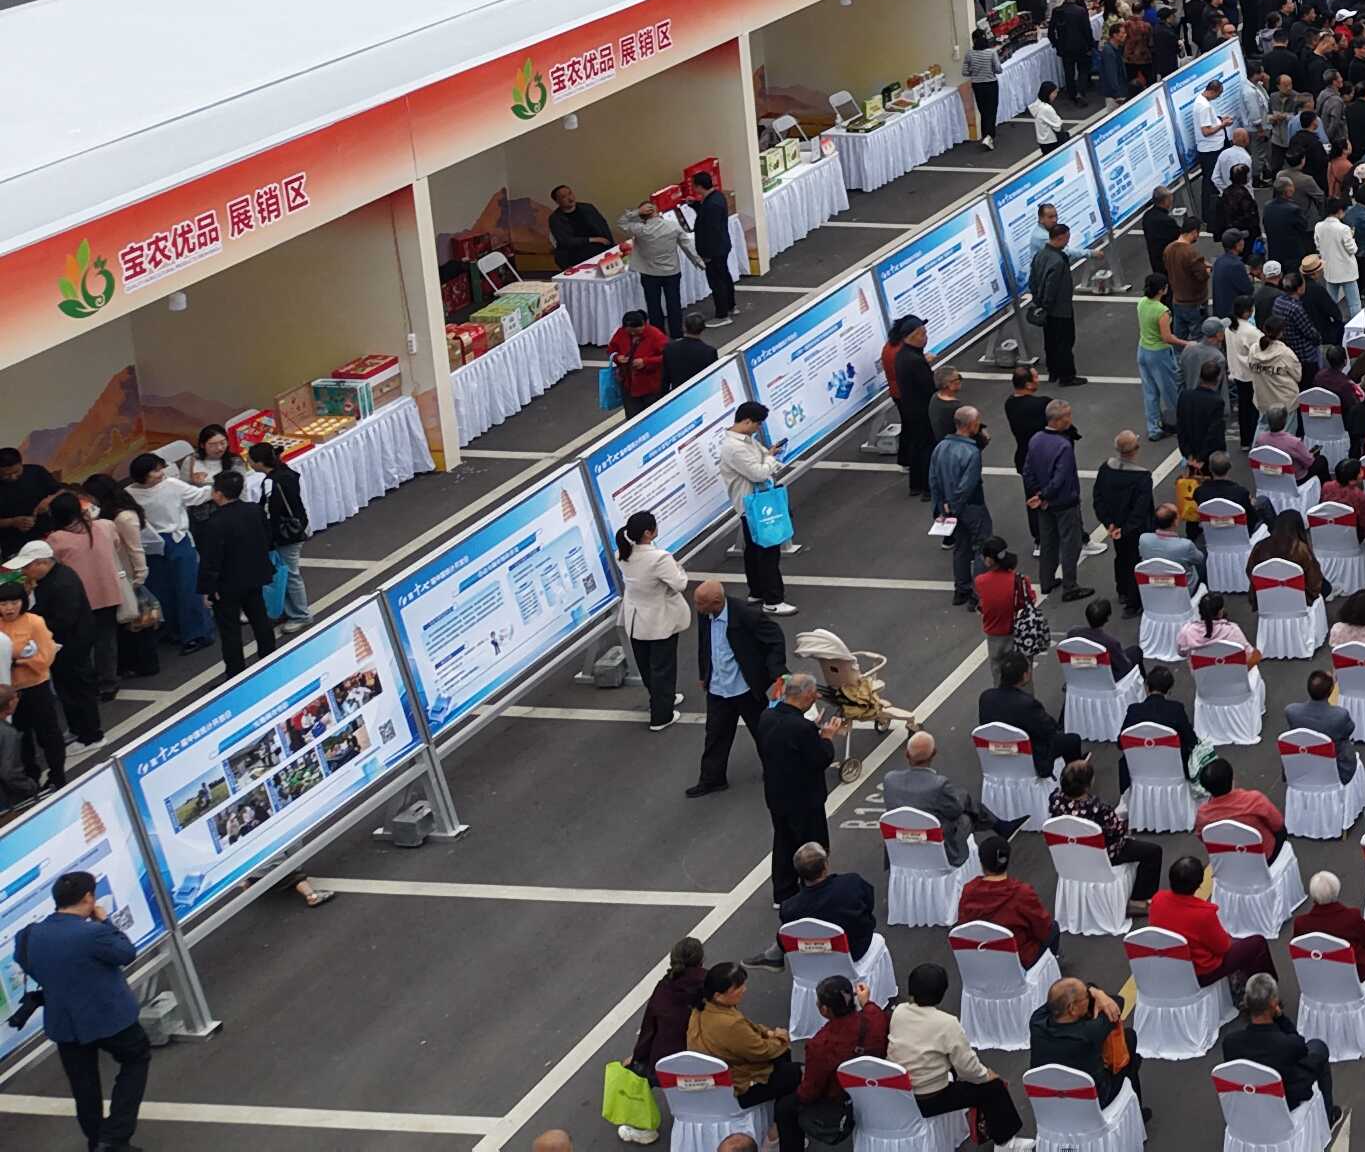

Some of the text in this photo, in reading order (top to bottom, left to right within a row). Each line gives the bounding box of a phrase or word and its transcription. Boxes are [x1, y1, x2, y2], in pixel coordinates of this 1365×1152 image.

[550, 18, 672, 95] 宝农优品 展销区
[120, 212, 220, 282] 宝农优品
[228, 174, 309, 238] 展销区
